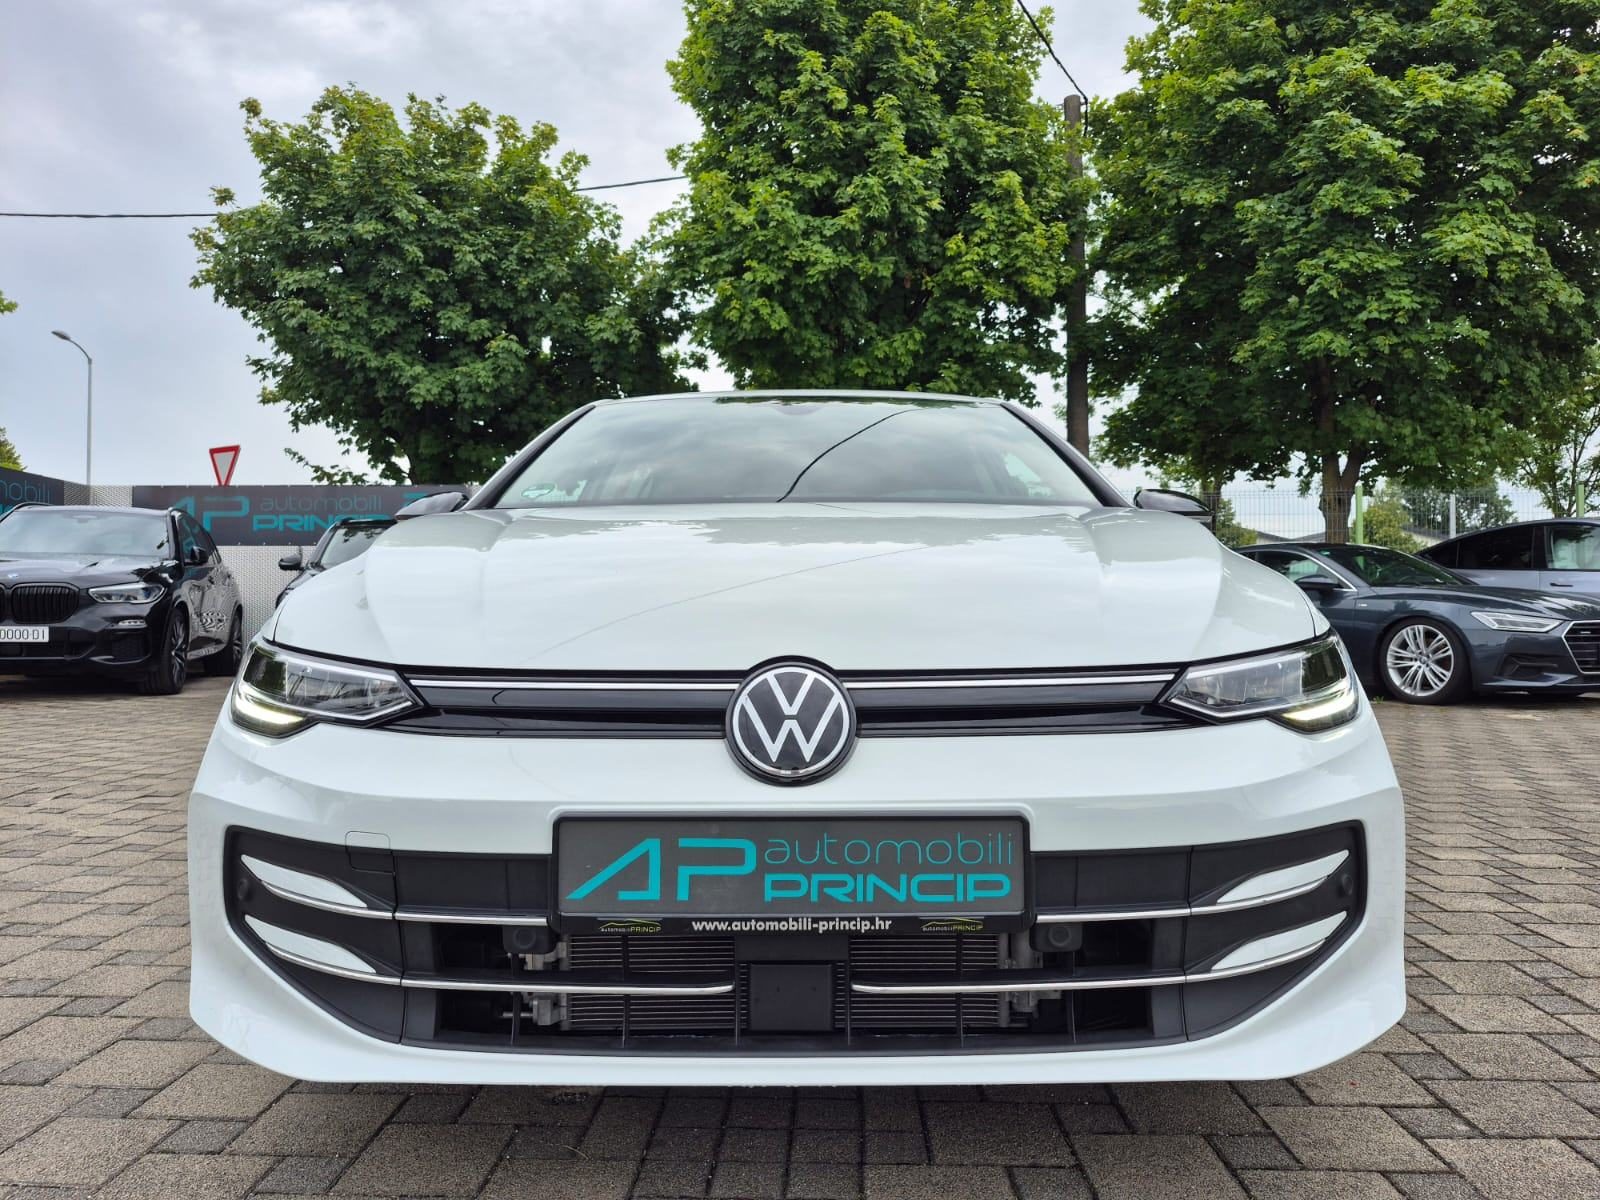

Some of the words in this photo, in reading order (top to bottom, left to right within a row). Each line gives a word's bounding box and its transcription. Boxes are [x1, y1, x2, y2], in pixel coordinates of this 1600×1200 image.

[260, 494, 382, 512] automobili
[253, 513, 393, 533] PRIN
[733, 666, 849, 777] VW
[566, 837, 757, 901] AP
[764, 832, 1015, 865] automobili
[764, 872, 1011, 903] PRINCIP
[692, 917, 892, 934] www.automobili-princip.hr
